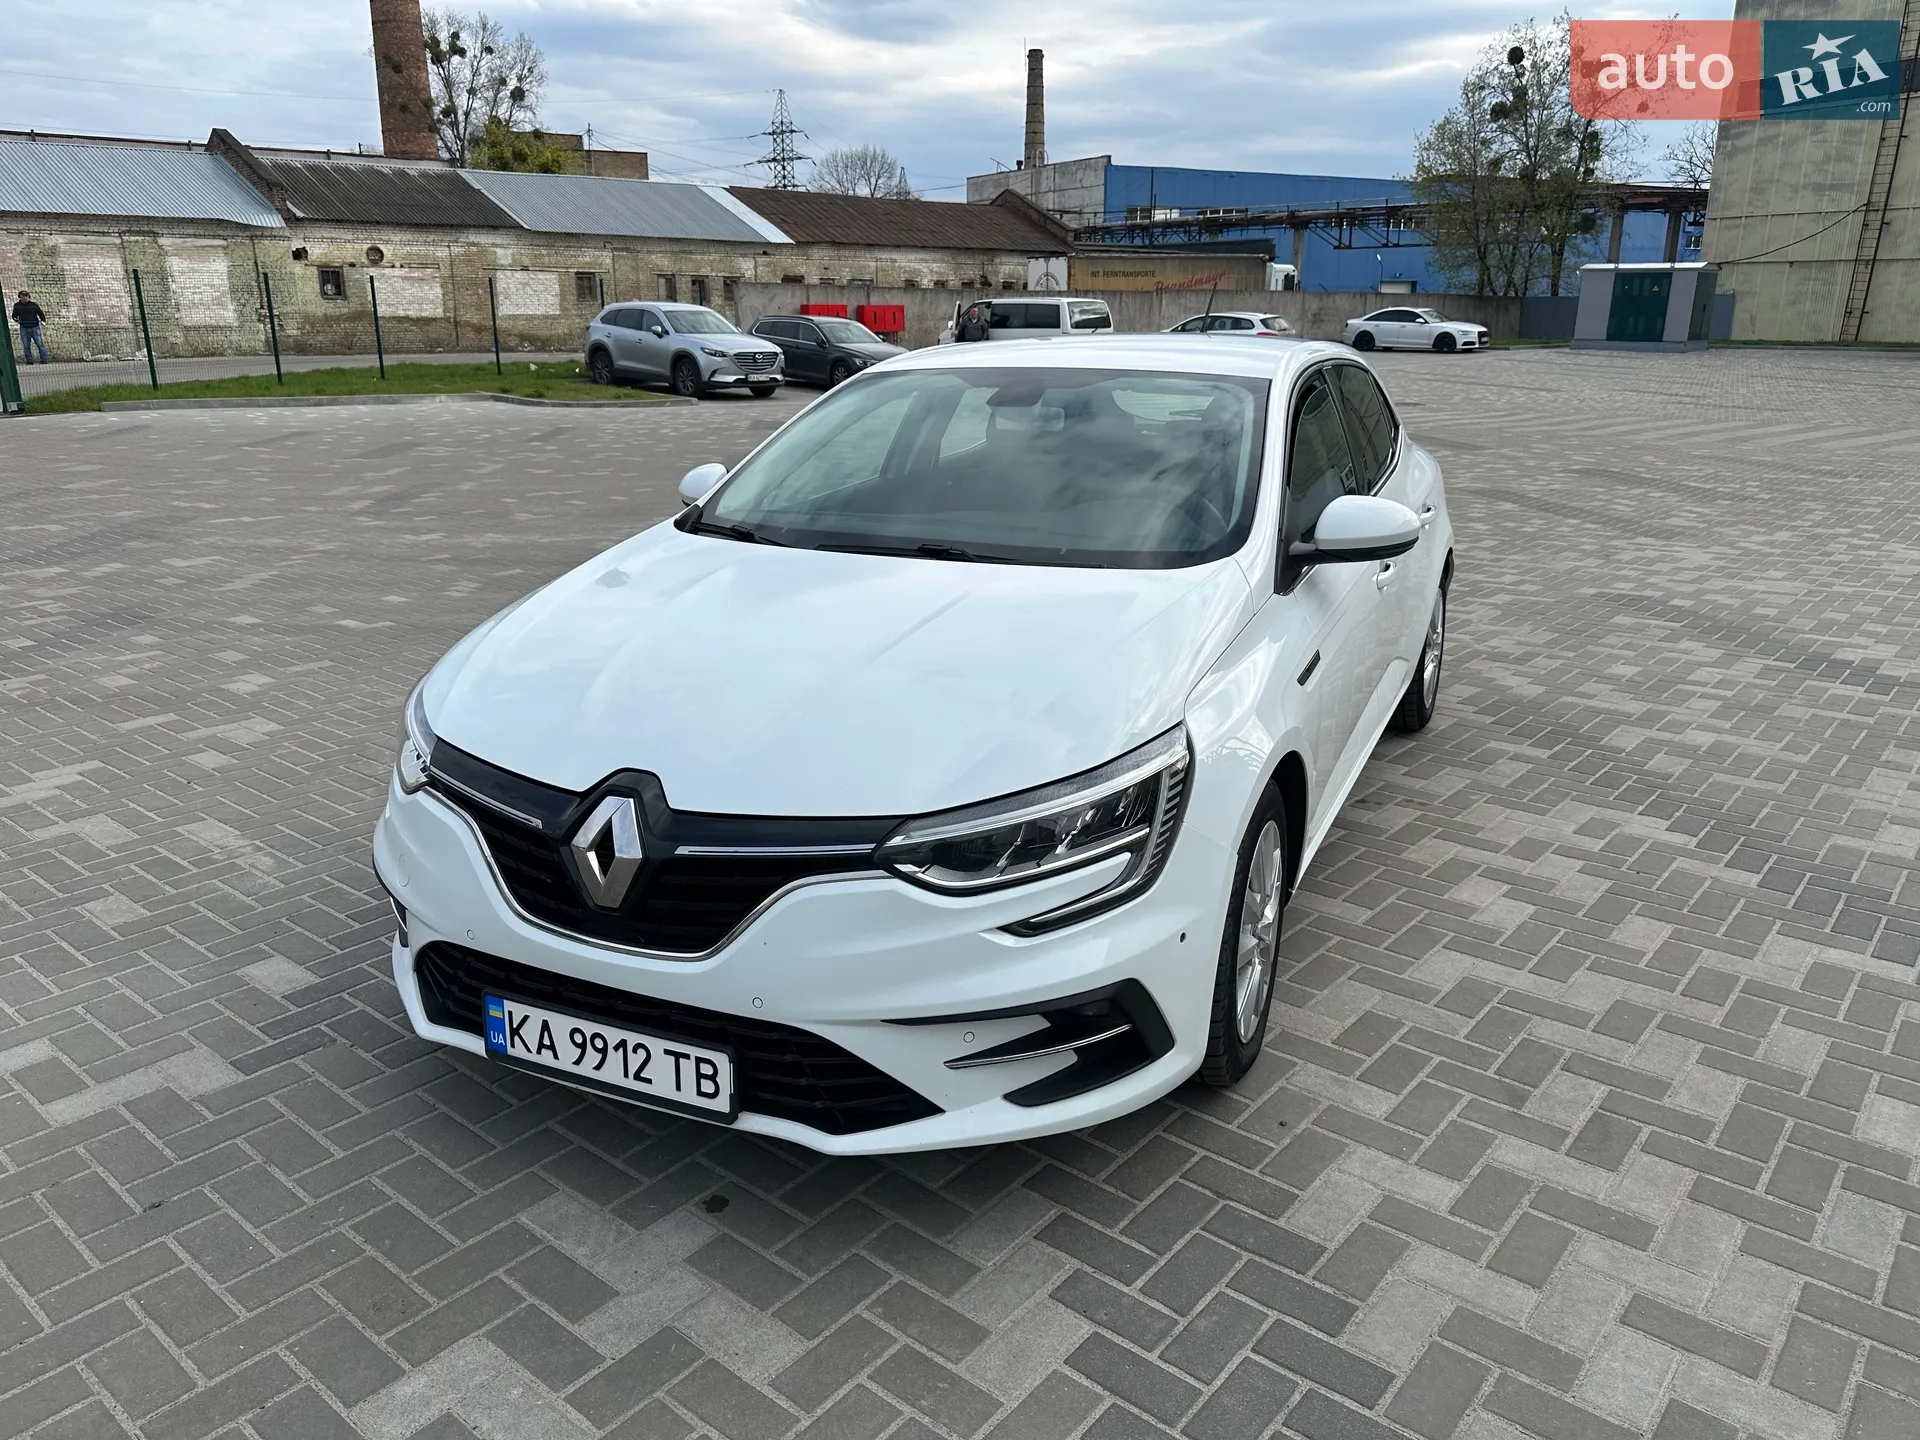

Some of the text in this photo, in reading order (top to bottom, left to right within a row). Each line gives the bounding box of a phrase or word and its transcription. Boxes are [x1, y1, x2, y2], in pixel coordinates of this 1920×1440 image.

[1102, 270, 1156, 278] FERNTRANSPORTE
[490, 1030, 505, 1046] UA
[507, 1010, 720, 1100] KA 9912 TB
